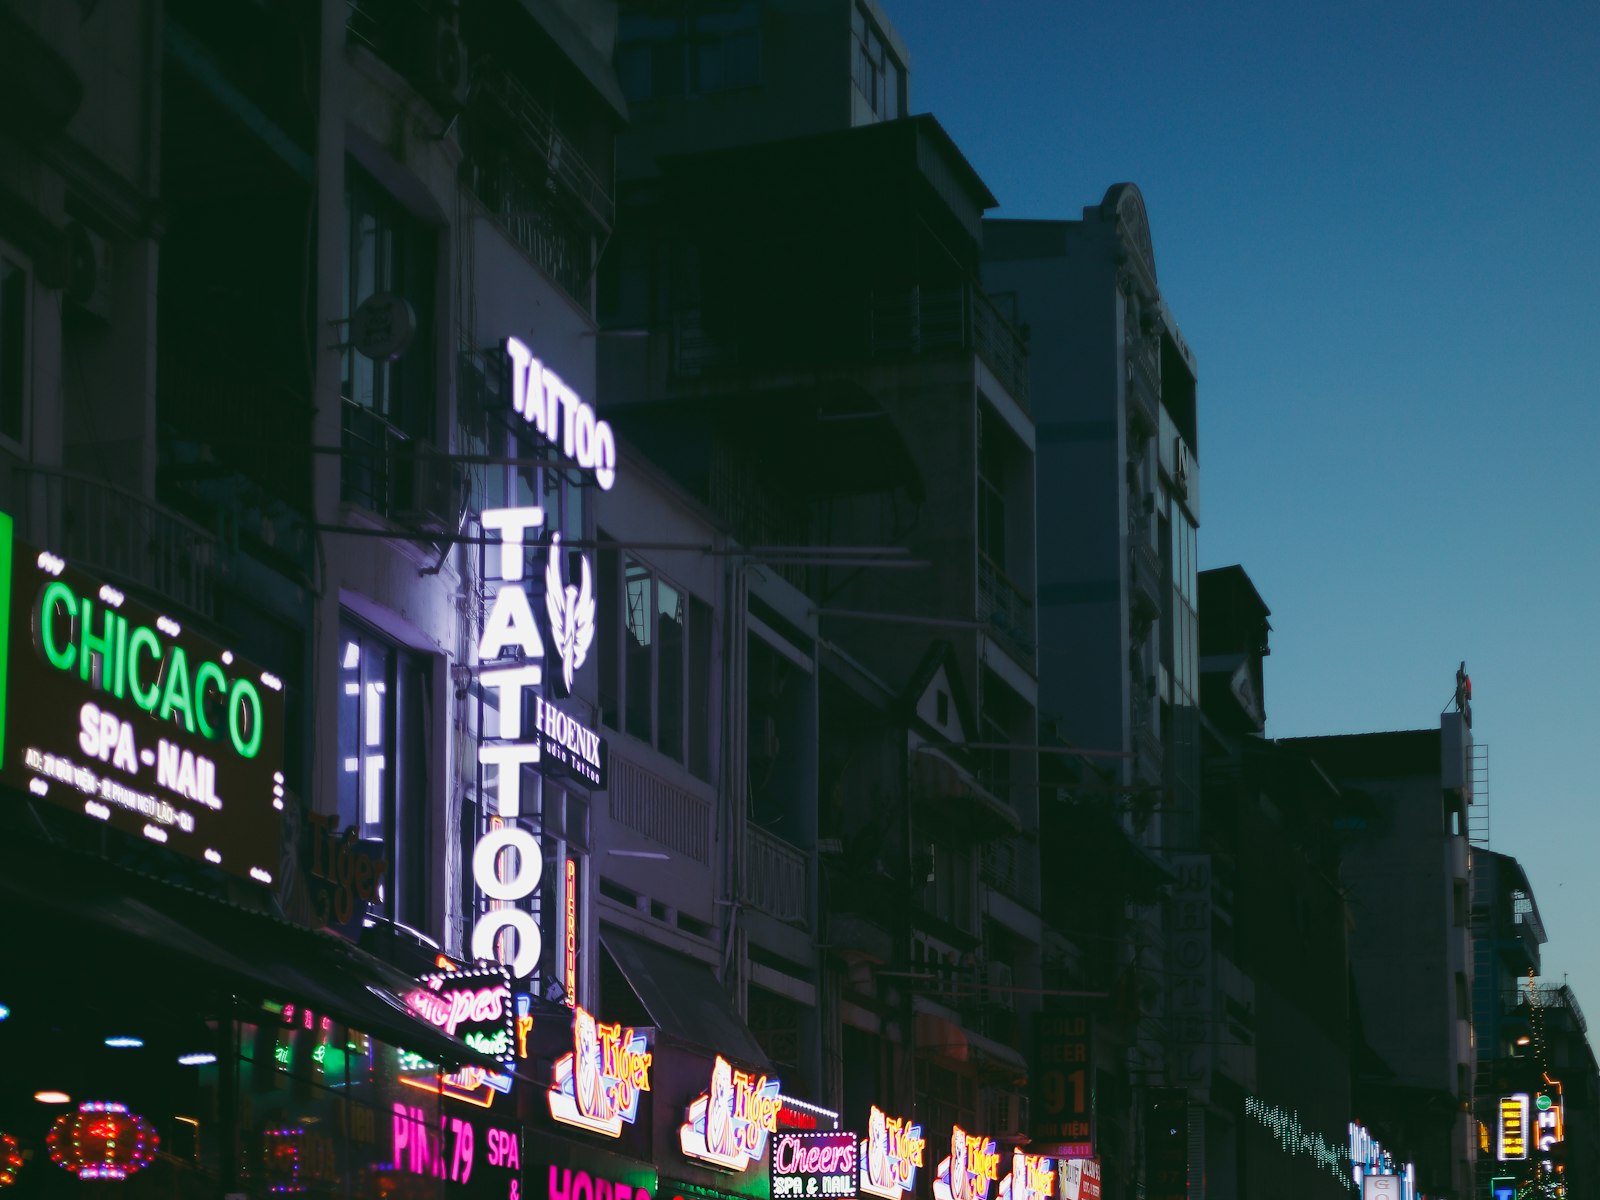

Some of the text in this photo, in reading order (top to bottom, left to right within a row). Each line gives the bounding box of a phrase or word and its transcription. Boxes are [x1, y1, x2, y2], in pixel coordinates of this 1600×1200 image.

[507, 337, 615, 490] TATTOO
[79, 702, 139, 775] SPA
[156, 738, 224, 811] NAIL
[471, 507, 544, 979] TATTOO
[571, 754, 600, 785] Tattoo
[566, 860, 575, 1007] PIERCING
[598, 1024, 653, 1112] Tiger
[733, 1070, 782, 1150] Tiger
[451, 1117, 475, 1186] 79
[487, 1128, 520, 1171] SPA
[776, 1136, 854, 1175] Cheers
[886, 1117, 926, 1182] Tiger
[965, 1134, 1000, 1196] Tiger
[775, 1176, 803, 1195] SPA
[806, 1177, 819, 1195] &
[822, 1175, 854, 1194] NAIL
